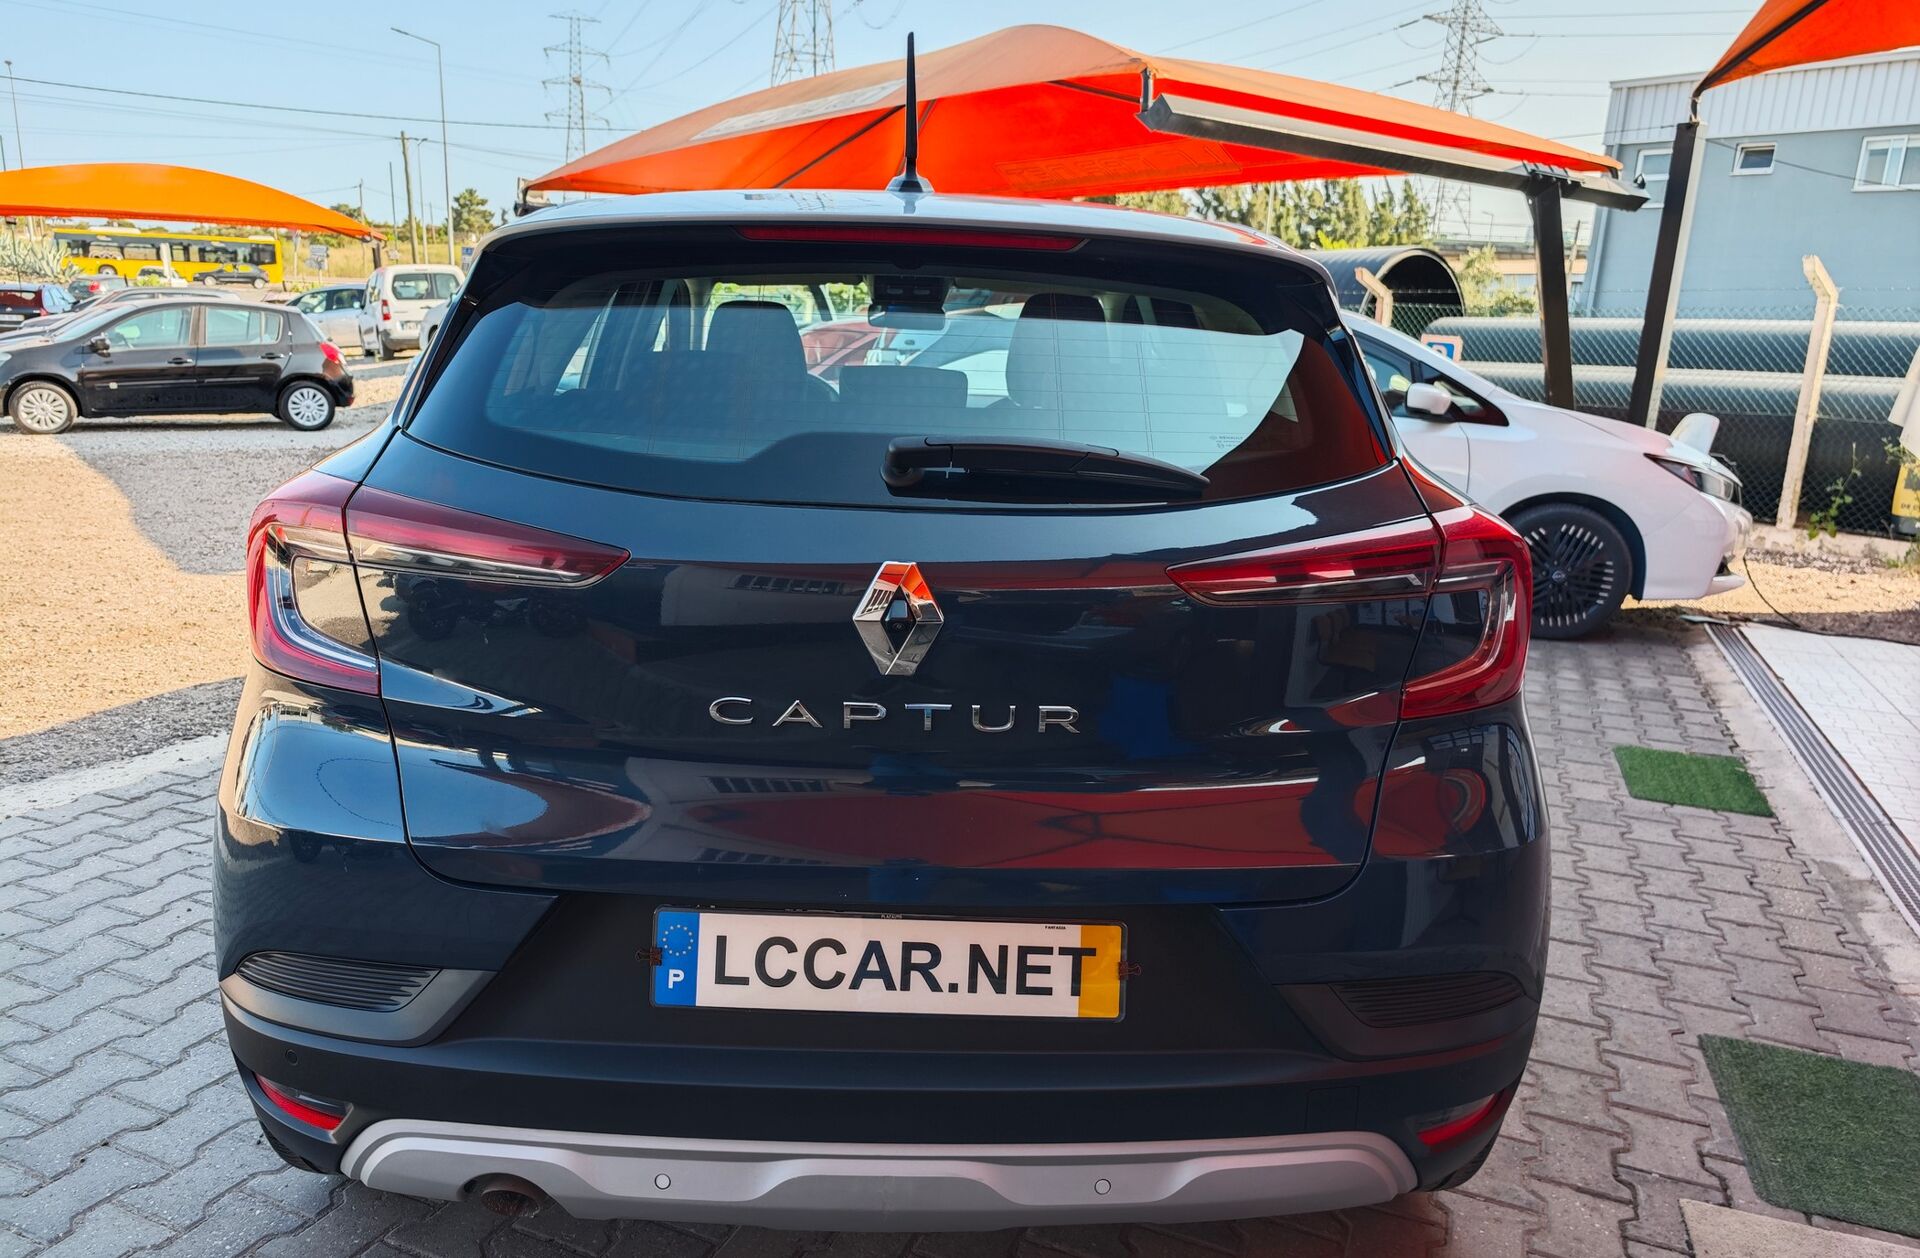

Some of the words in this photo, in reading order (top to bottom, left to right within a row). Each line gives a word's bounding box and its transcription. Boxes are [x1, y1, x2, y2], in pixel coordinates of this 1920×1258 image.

[709, 696, 1080, 733] CAPTUR
[668, 969, 685, 989] P
[715, 935, 1096, 997] LCCAR.NET
